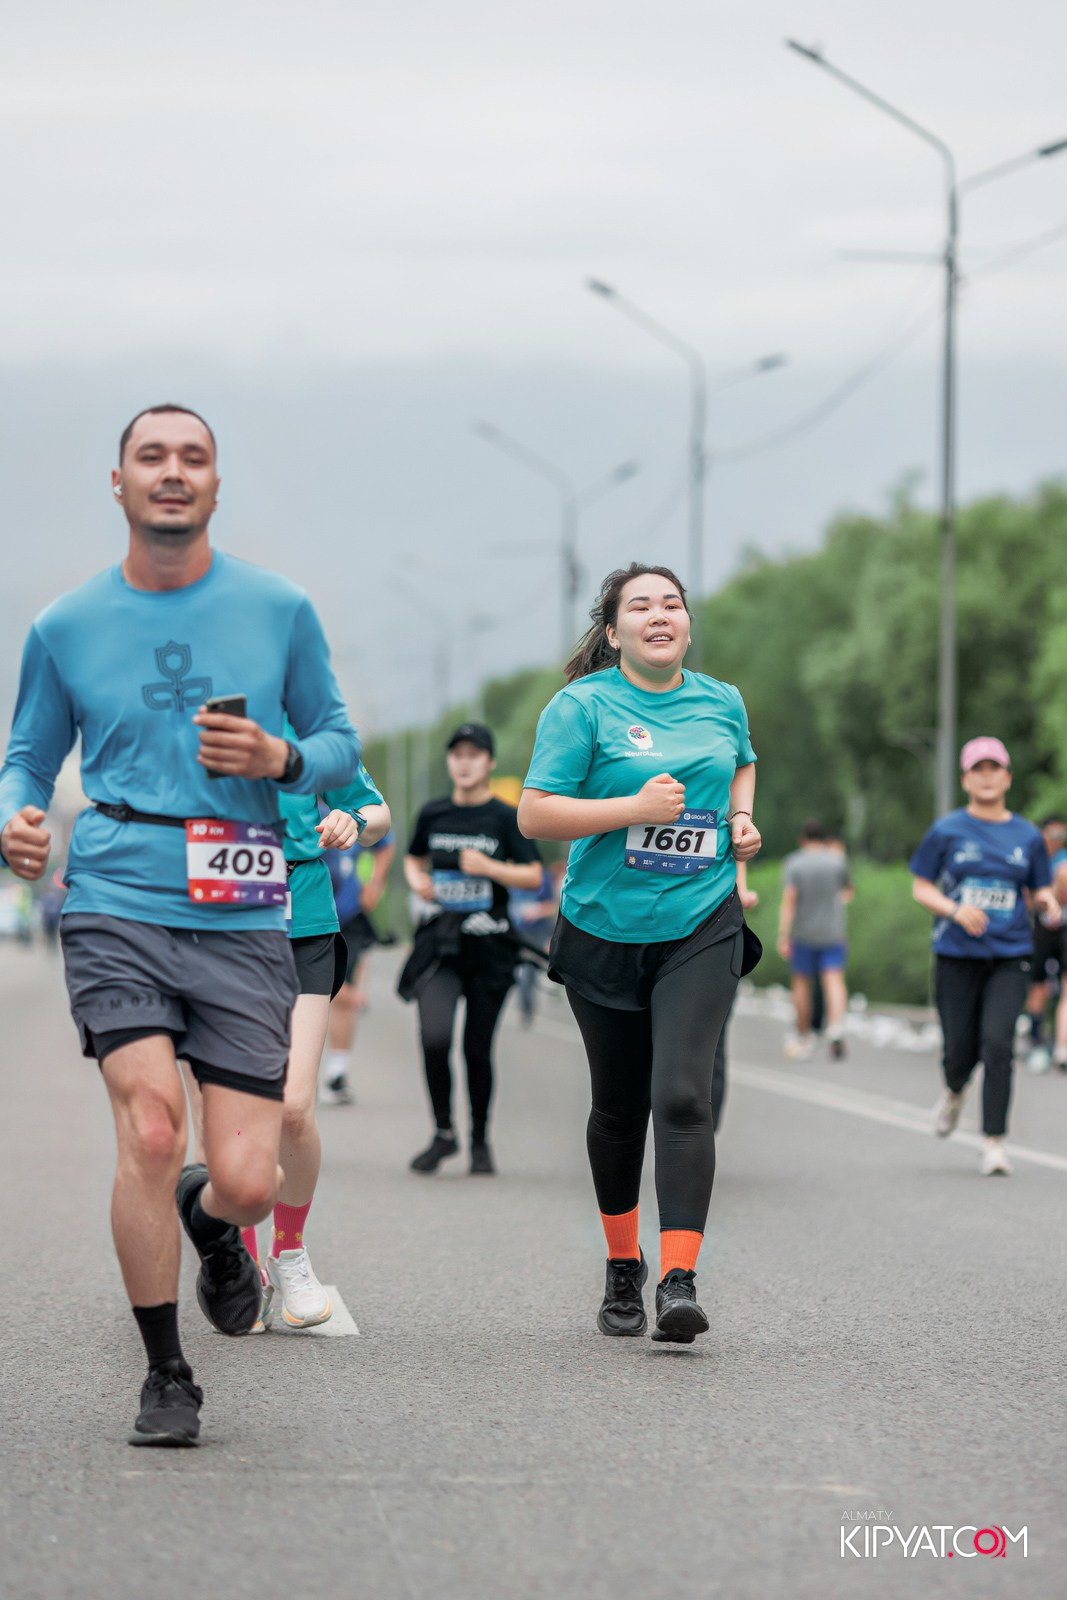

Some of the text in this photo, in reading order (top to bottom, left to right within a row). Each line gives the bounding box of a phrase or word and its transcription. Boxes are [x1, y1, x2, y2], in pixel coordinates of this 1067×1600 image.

[192, 824, 208, 836] 10
[642, 826, 706, 854] 1661
[208, 848, 274, 876] 409
